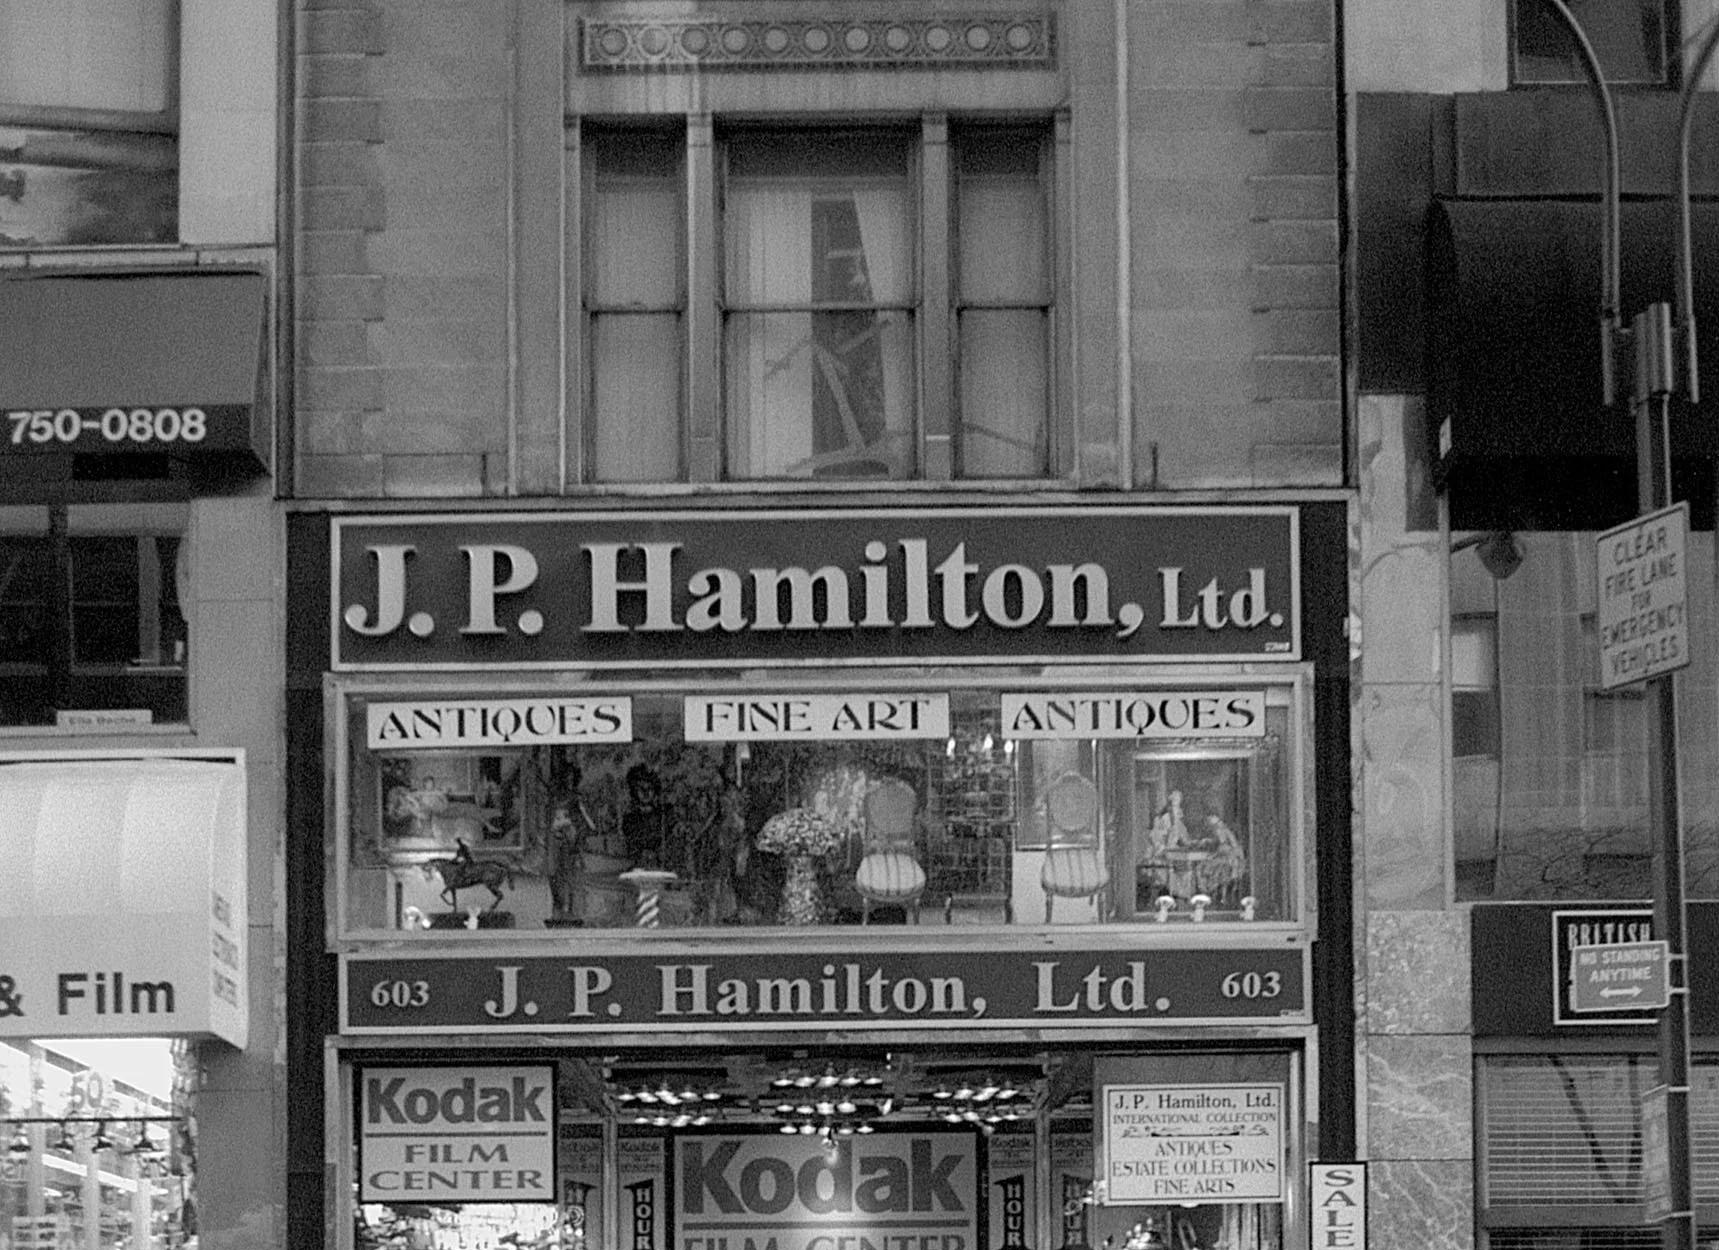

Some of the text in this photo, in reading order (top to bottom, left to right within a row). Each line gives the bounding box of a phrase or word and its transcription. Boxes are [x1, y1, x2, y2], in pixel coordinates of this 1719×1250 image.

[9, 408, 206, 443] 750-0808
[1615, 526, 1667, 566] CLEAR
[344, 538, 1285, 638] J. P. Hamilton, Ltd.
[1606, 552, 1677, 596] FIRE LANE
[1602, 603, 1682, 650] EMERGENCY
[1611, 634, 1678, 676] VEHICLES
[378, 703, 623, 742] ANTIQUES
[705, 699, 931, 733] FINE ART
[1012, 698, 1256, 736] ANTIQUES
[1568, 923, 1651, 950] BRITISH
[1601, 947, 1661, 964] STANDING
[370, 960, 1281, 1020] 603 J. P. Hamilton, Ltd. 603
[1589, 966, 1651, 983] ANYTIME
[0, 974, 25, 1018] &
[57, 971, 175, 1015] Film
[367, 1076, 547, 1125] Kodak
[1113, 1111, 1277, 1125] INTERNATIONAL COLLECTION
[1158, 1093, 1237, 1110] Hamilton,
[1245, 1092, 1277, 1108] Ltd.
[404, 1143, 509, 1164] FILM
[1112, 1157, 1277, 1177] ESTATE COLLECTIONS
[1155, 1140, 1233, 1157] ANTIQUES
[369, 1169, 545, 1191] CENTER
[682, 1138, 966, 1215] Kodak
[1154, 1177, 1236, 1195] FINE ARTS
[636, 1187, 651, 1250] HOUR
[1006, 1183, 1022, 1246] HOUR
[1322, 1168, 1358, 1248] SALE
